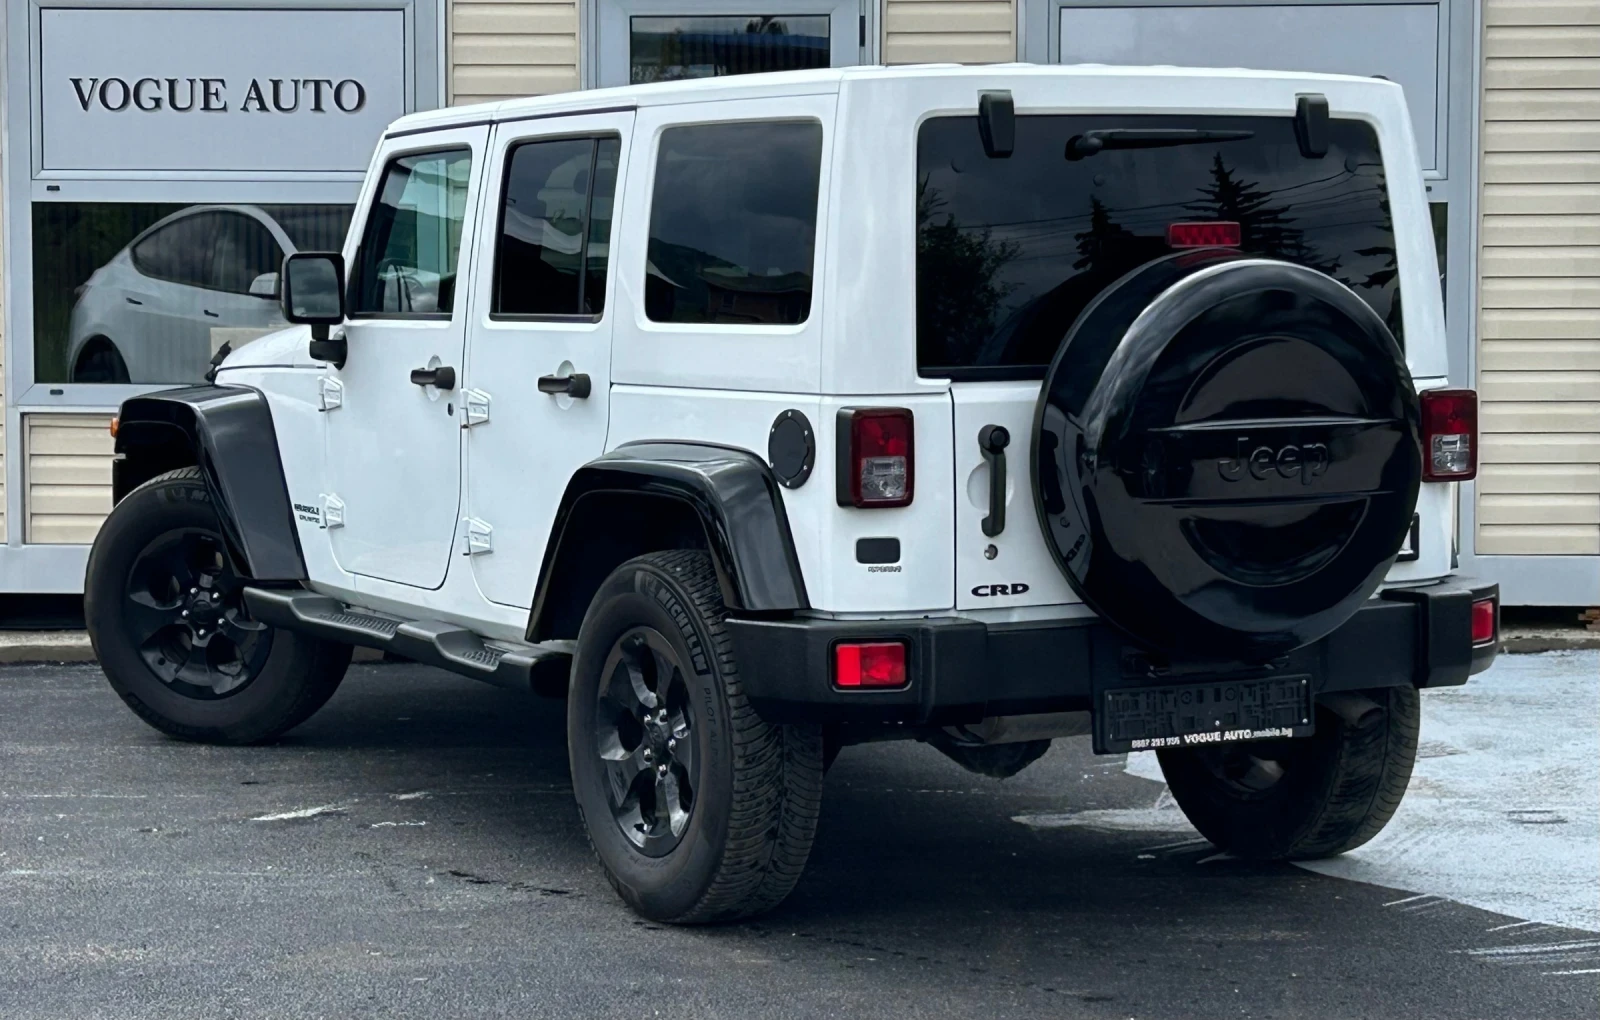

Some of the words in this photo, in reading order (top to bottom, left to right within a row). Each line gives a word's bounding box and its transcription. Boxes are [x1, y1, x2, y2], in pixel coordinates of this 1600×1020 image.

[69, 77, 228, 113] VOGUE
[239, 77, 367, 113] AUTO
[1217, 436, 1329, 486] Jeep
[971, 583, 1030, 597] CRD
[656, 587, 708, 672] MICHELIN
[1183, 730, 1221, 744] VOGUE
